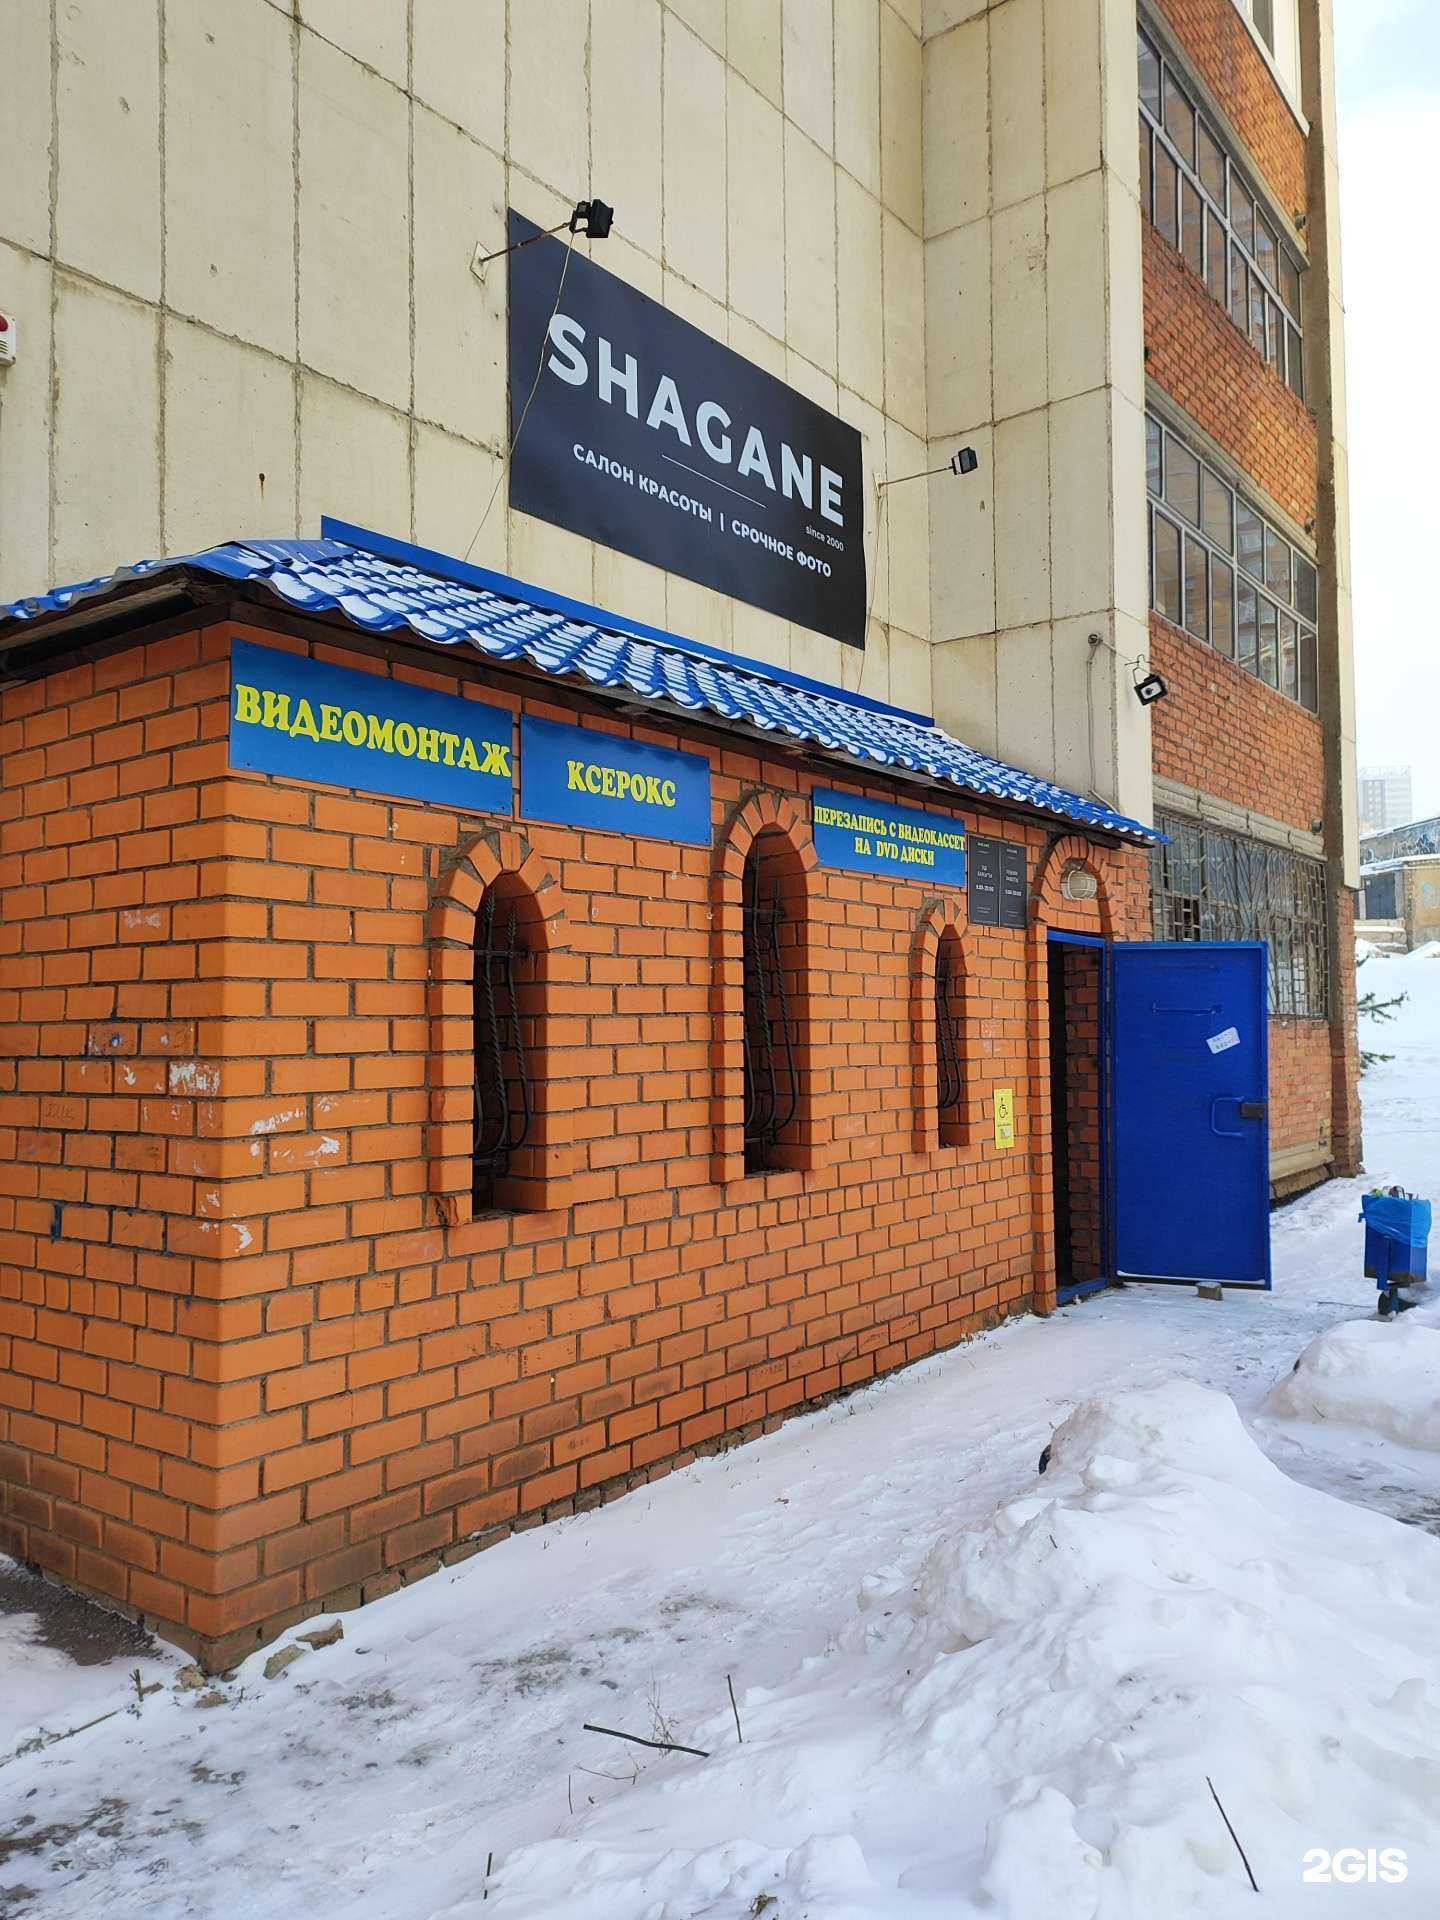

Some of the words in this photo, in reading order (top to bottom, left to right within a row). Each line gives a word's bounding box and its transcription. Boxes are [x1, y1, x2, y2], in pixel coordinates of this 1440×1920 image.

[548, 313, 844, 527] SHAGANE
[573, 443, 634, 485] САЛОН
[638, 474, 712, 522] КРАСОТЫ
[731, 519, 794, 561] СРОЧНОЕ
[796, 550, 832, 578] ФОТО
[805, 524, 826, 542] since
[826, 534, 845, 552] 2000
[234, 683, 512, 778] ВИДЕОМОНТАЖ
[567, 760, 677, 807] КСЕРОКС
[814, 805, 887, 836] ПЕРЕЗАПИСЬ
[889, 822, 897, 838] С
[898, 823, 966, 851] ВИДЕОКАССЕТ
[855, 837, 872, 856] НА
[876, 840, 898, 860] DVD
[900, 846, 935, 866] ДИСКИ
